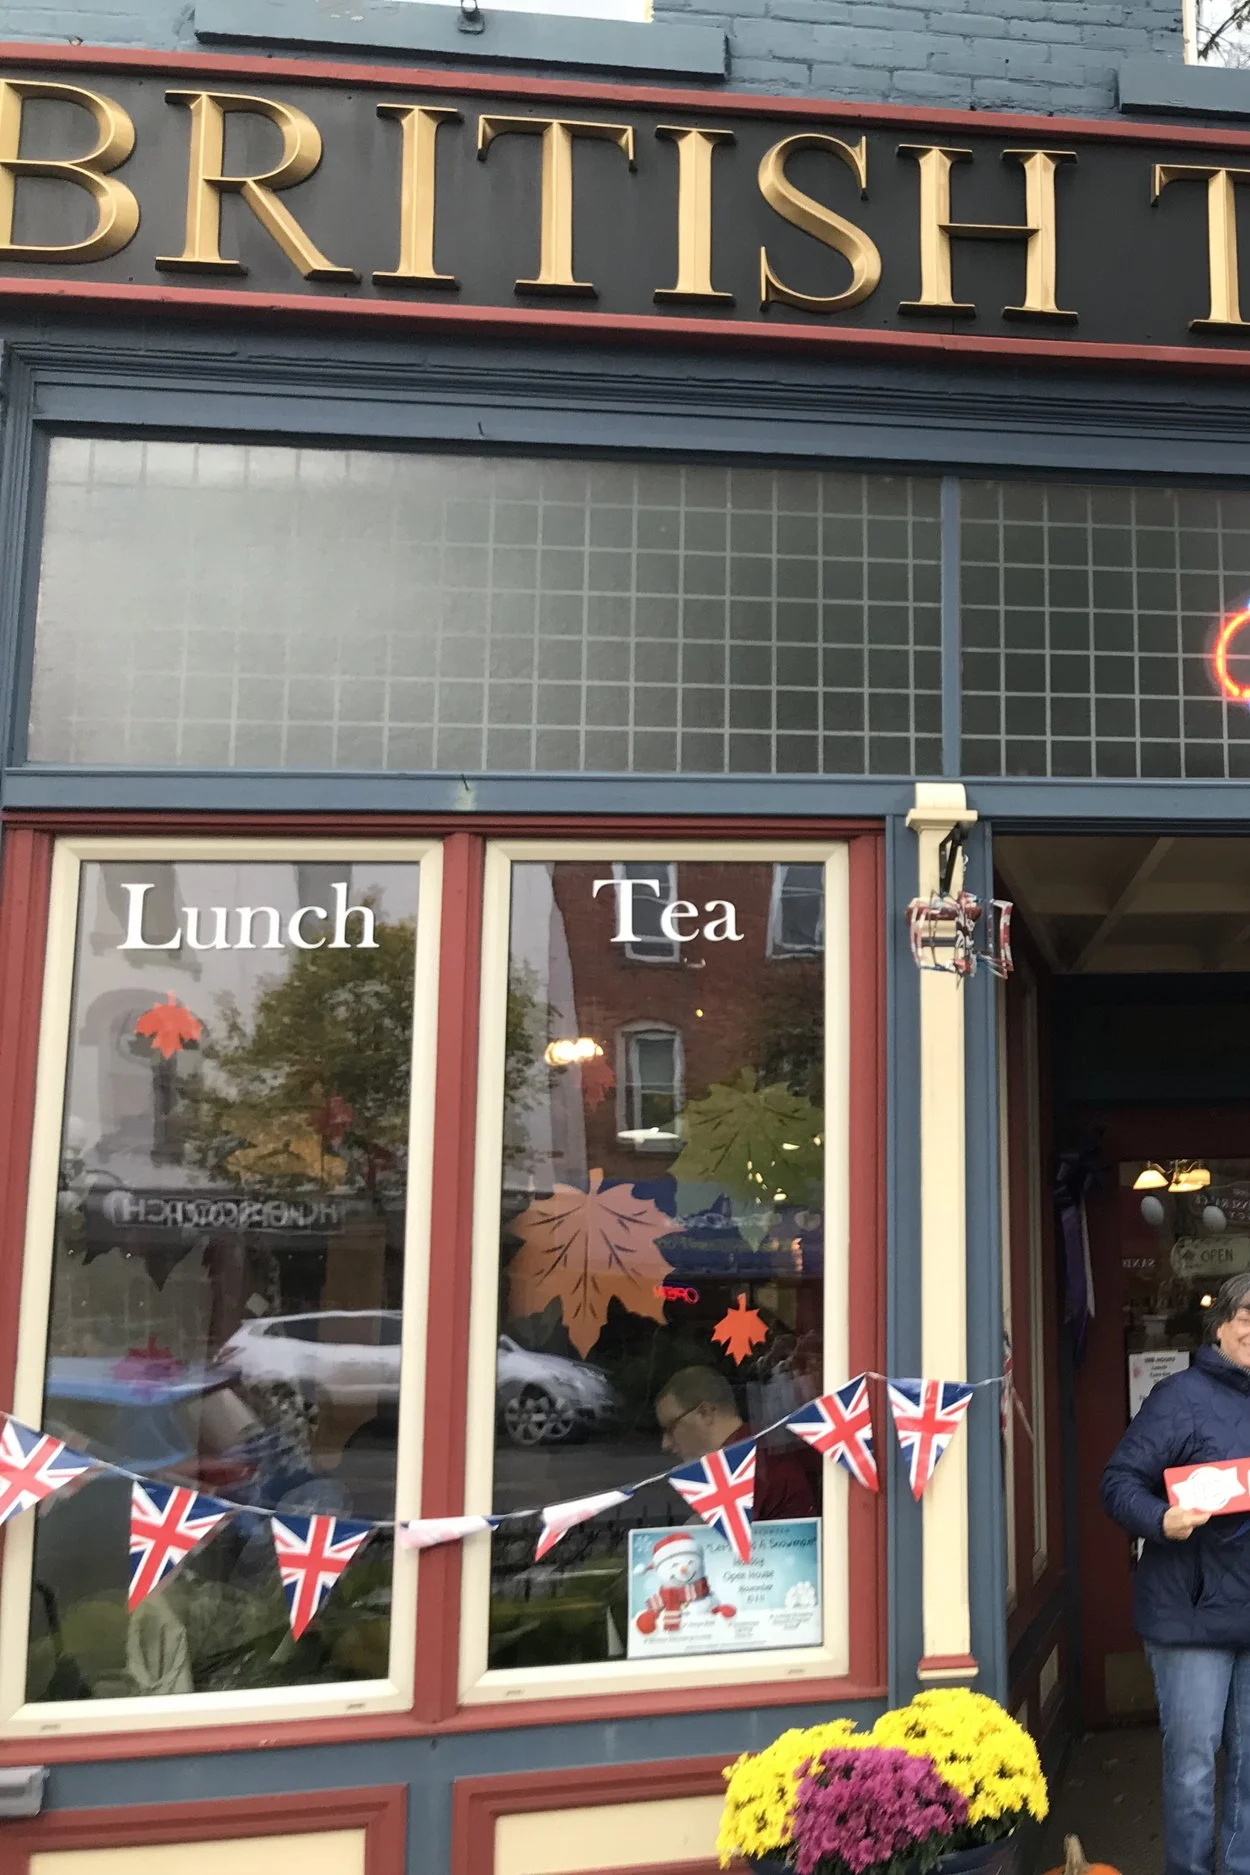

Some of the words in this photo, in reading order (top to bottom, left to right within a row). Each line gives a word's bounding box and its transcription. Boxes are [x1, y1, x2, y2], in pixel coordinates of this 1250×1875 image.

[0, 78, 1079, 326] BRITISH
[116, 882, 381, 950] Lunch
[592, 878, 745, 943] Tea
[1200, 1248, 1235, 1263] OPEN
